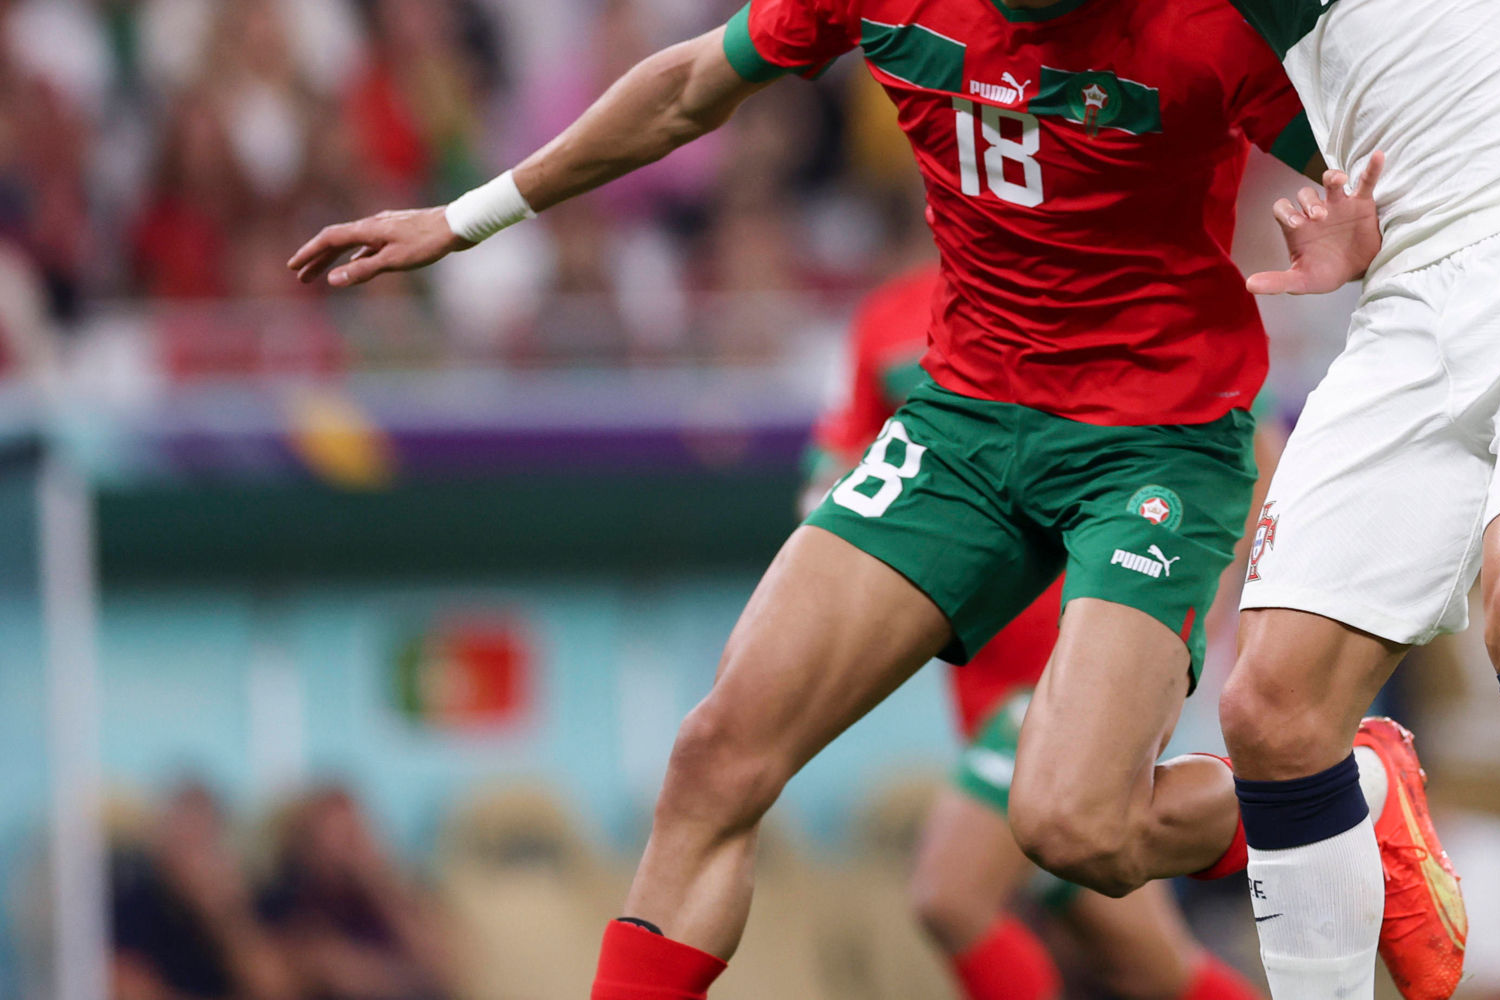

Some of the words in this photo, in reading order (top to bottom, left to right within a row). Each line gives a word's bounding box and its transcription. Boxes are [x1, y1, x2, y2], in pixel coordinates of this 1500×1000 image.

[970, 80, 1017, 104] PUMA
[951, 96, 1044, 208] 18
[826, 416, 928, 518] 8
[1110, 548, 1164, 578] PUMA
